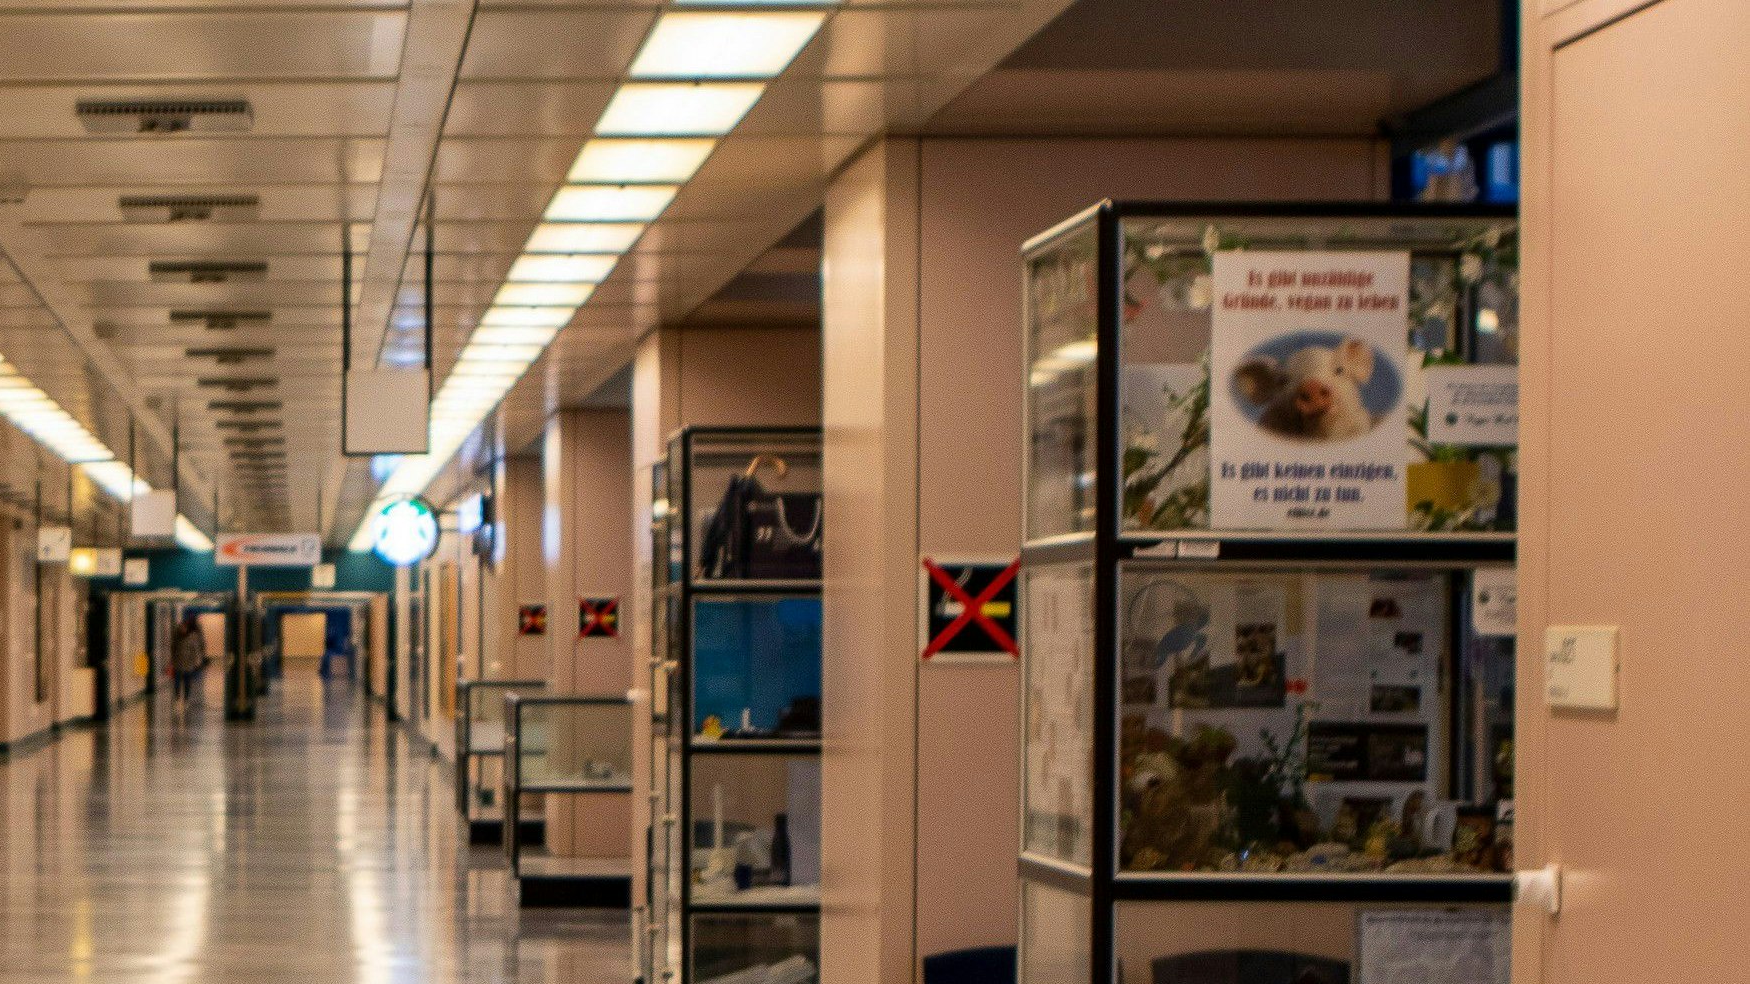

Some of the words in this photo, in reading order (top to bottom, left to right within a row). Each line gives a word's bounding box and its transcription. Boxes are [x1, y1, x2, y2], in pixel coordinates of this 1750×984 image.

[1247, 270, 1263, 287] Es
[1267, 270, 1296, 289] gibt
[1287, 295, 1332, 311] vegan
[1336, 295, 1353, 310] zu
[1357, 292, 1399, 310] leben
[1221, 462, 1236, 479] Es
[1241, 462, 1270, 481] gibt
[1274, 462, 1325, 479] keinen
[1329, 462, 1397, 481] einzigen,
[1253, 487, 1269, 502] es
[1273, 486, 1310, 502] nicht
[1315, 487, 1331, 502] zu
